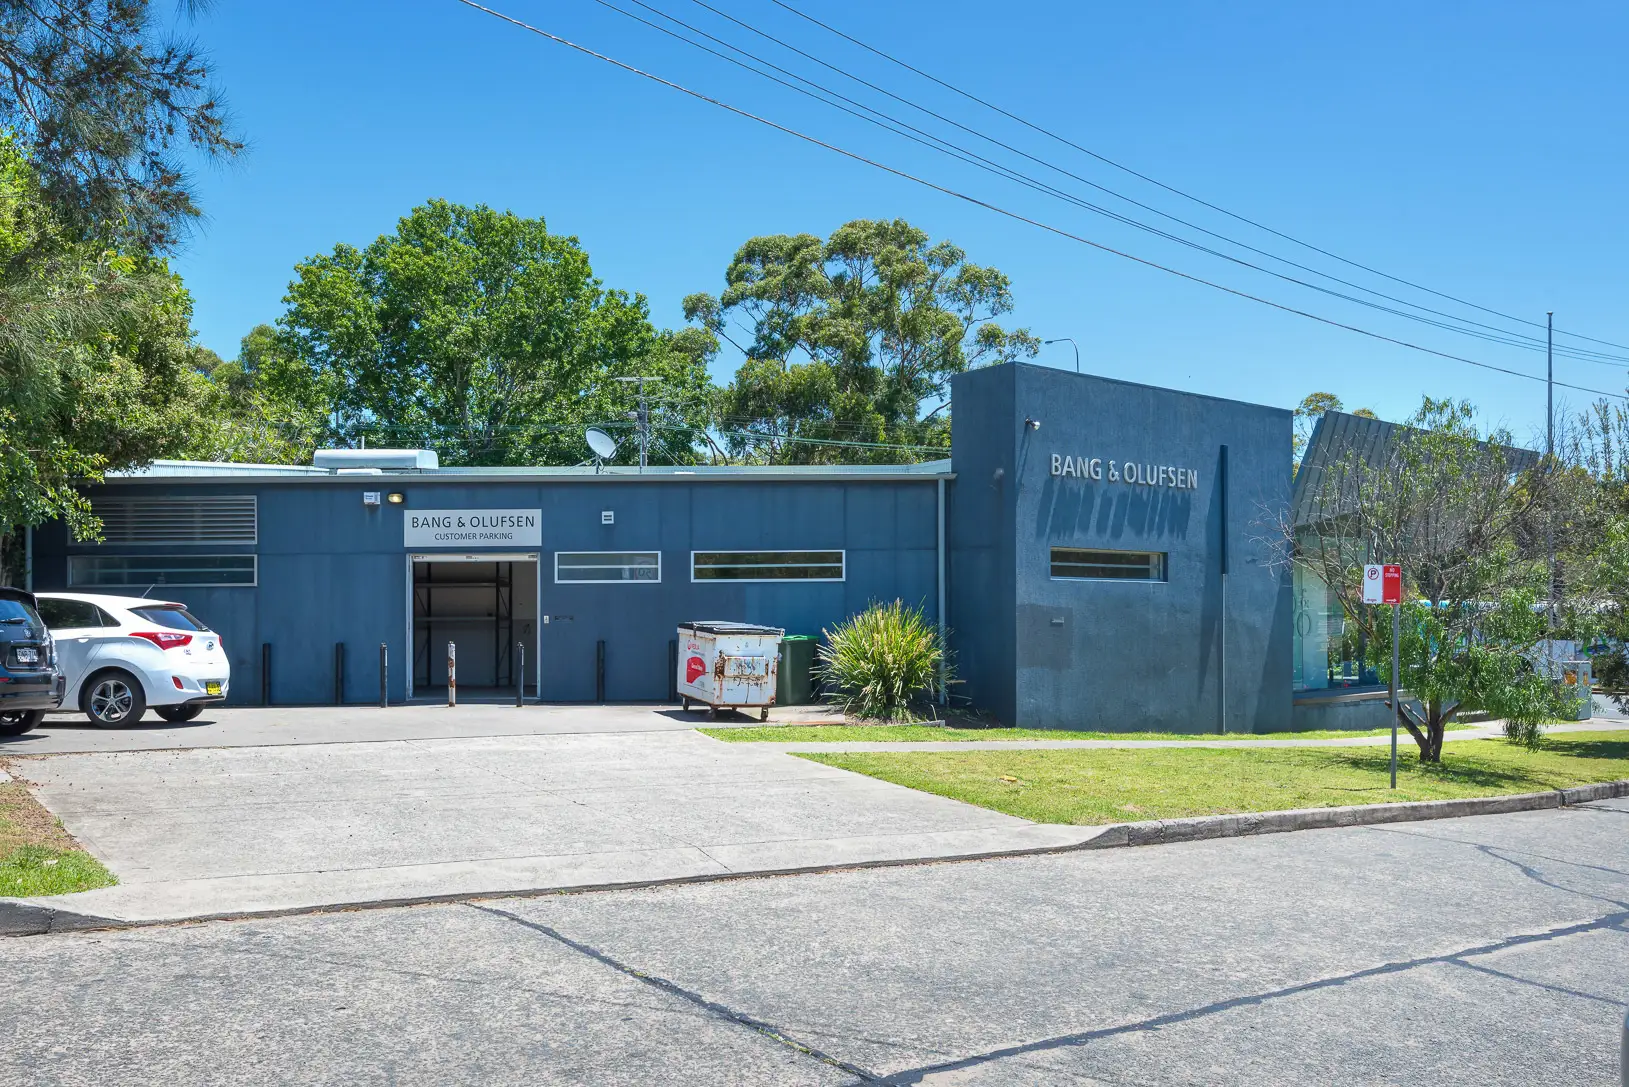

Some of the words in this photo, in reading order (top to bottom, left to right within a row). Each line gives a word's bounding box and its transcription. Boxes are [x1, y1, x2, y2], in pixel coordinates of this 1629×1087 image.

[1051, 453, 1102, 480] BANG
[1108, 460, 1120, 482] &
[1124, 462, 1198, 489] OLUFSEN
[411, 516, 452, 528] BANG
[457, 516, 466, 528] &
[470, 515, 535, 528] OLUFSEN
[434, 532, 478, 541] CUSTOMER
[479, 532, 513, 540] PARKING
